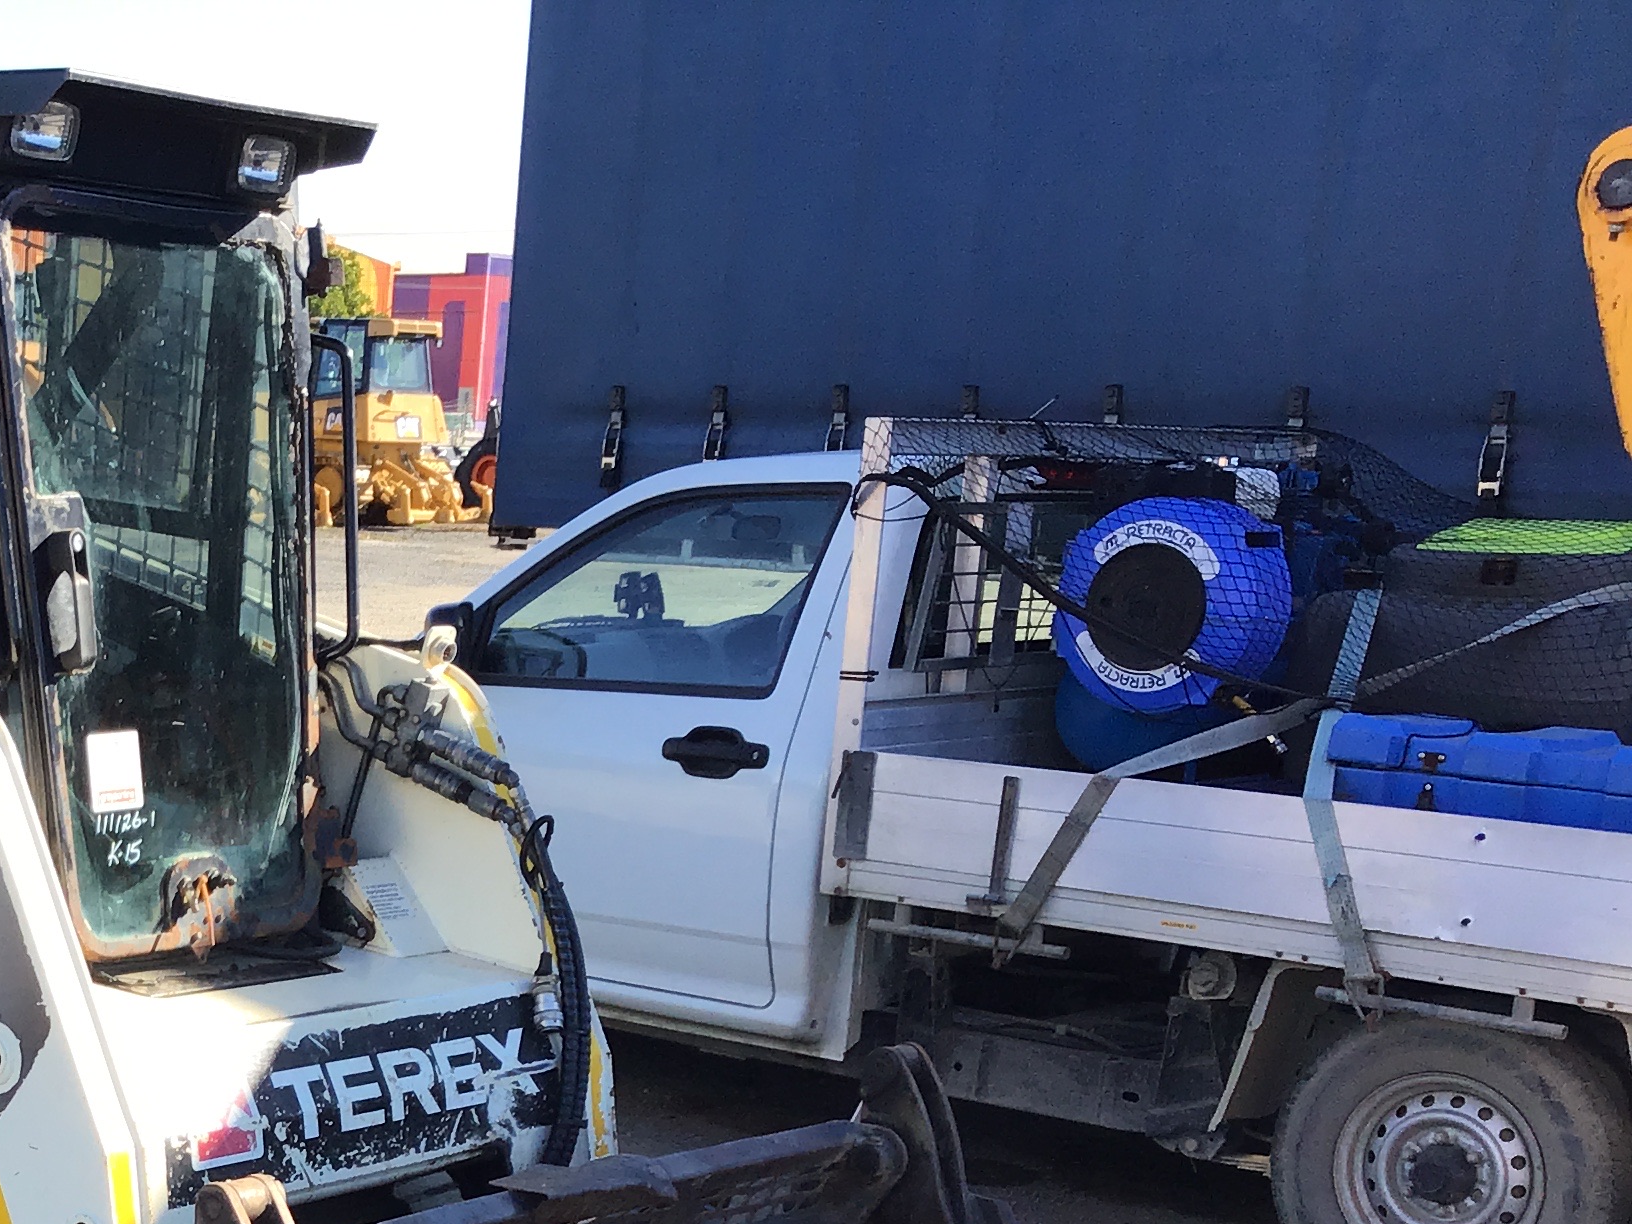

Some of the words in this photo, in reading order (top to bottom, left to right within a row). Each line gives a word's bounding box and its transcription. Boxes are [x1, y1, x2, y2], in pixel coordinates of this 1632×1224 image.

[326, 411, 343, 431] CA
[1125, 522, 1197, 550] RETRACTA
[1096, 660, 1167, 690] RETRACTA
[270, 1027, 540, 1140] TEREX
